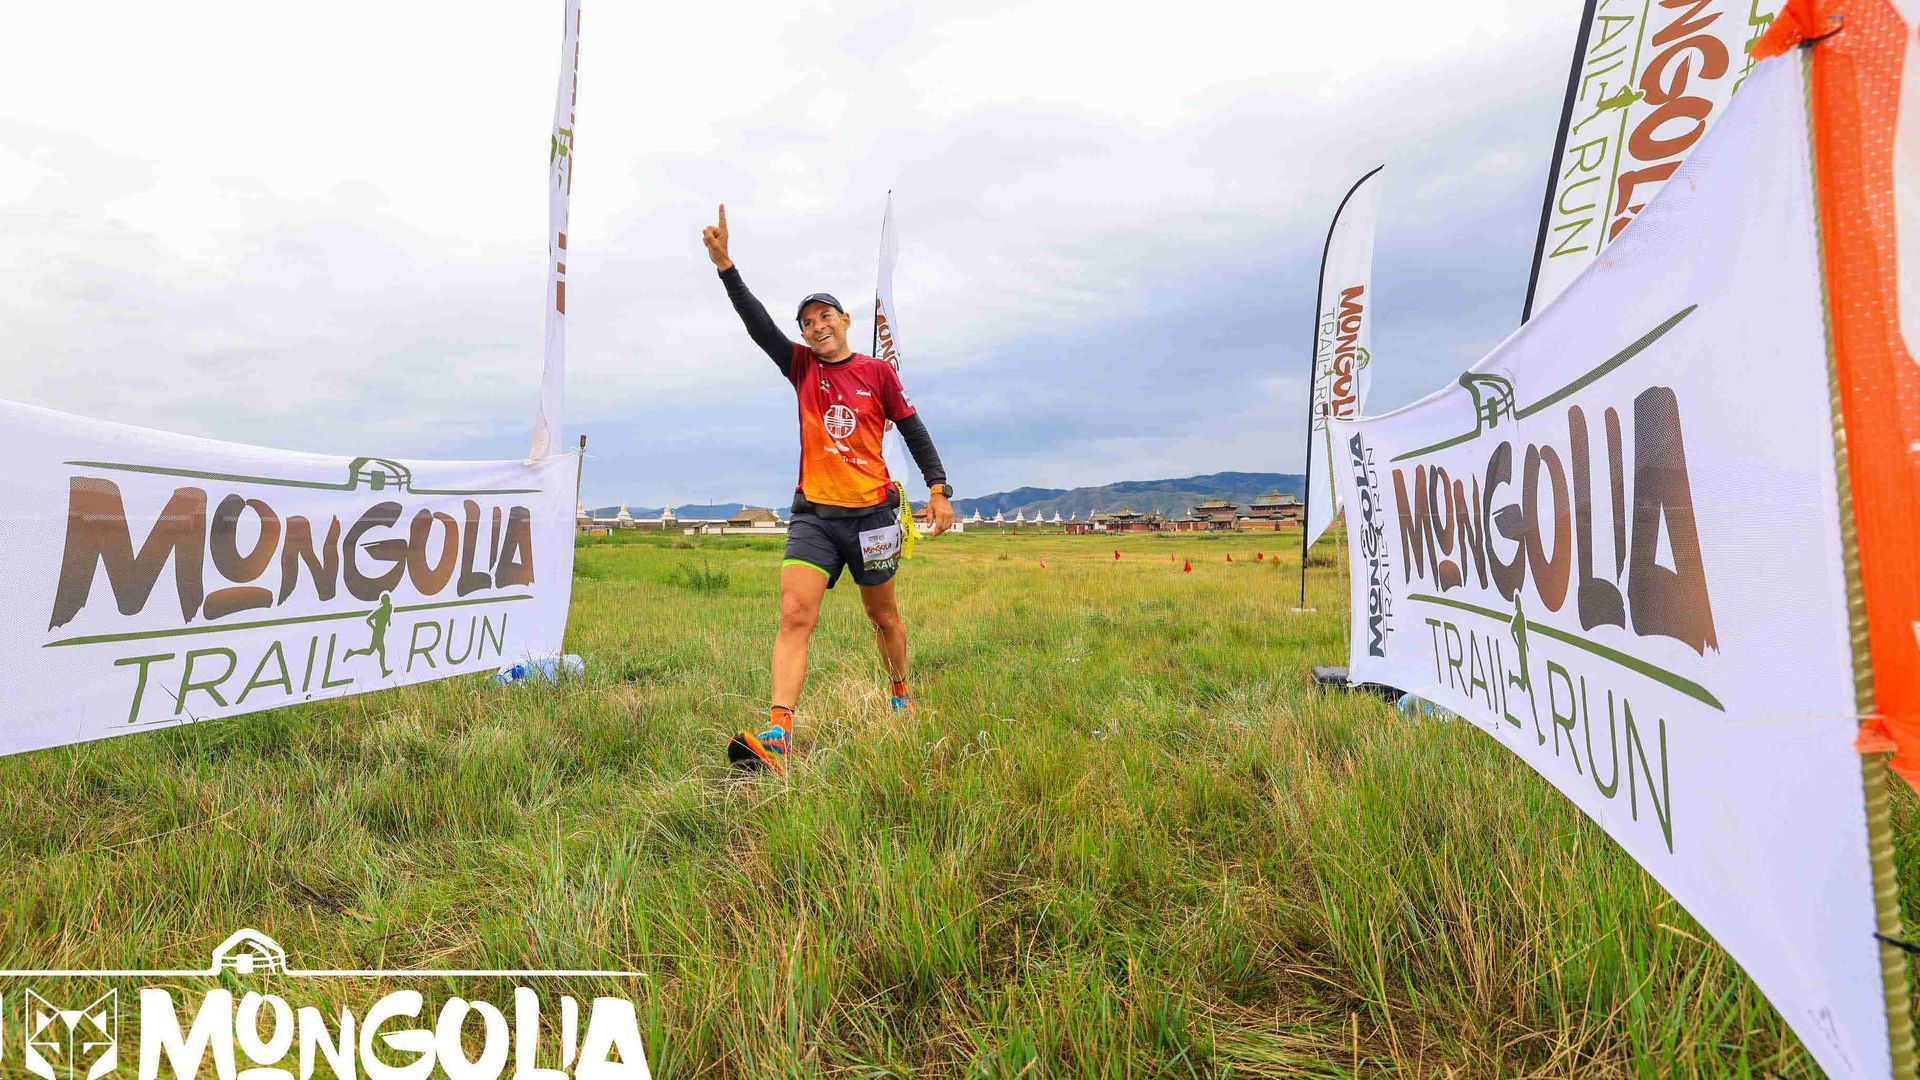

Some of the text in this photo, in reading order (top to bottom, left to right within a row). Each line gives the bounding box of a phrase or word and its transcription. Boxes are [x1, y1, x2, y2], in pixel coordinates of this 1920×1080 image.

[1549, 136, 1608, 259] RUN
[1313, 307, 1335, 432] TRAIL RUN
[47, 475, 536, 633] MONGOLIA
[1350, 431, 1385, 658] MONGOLIA
[1365, 447, 1395, 639] TRAIL RUN
[1391, 385, 1720, 657] MONGOLIA
[113, 612, 508, 724] TRAIL RUN
[1424, 617, 1674, 855] TRAIL RUN
